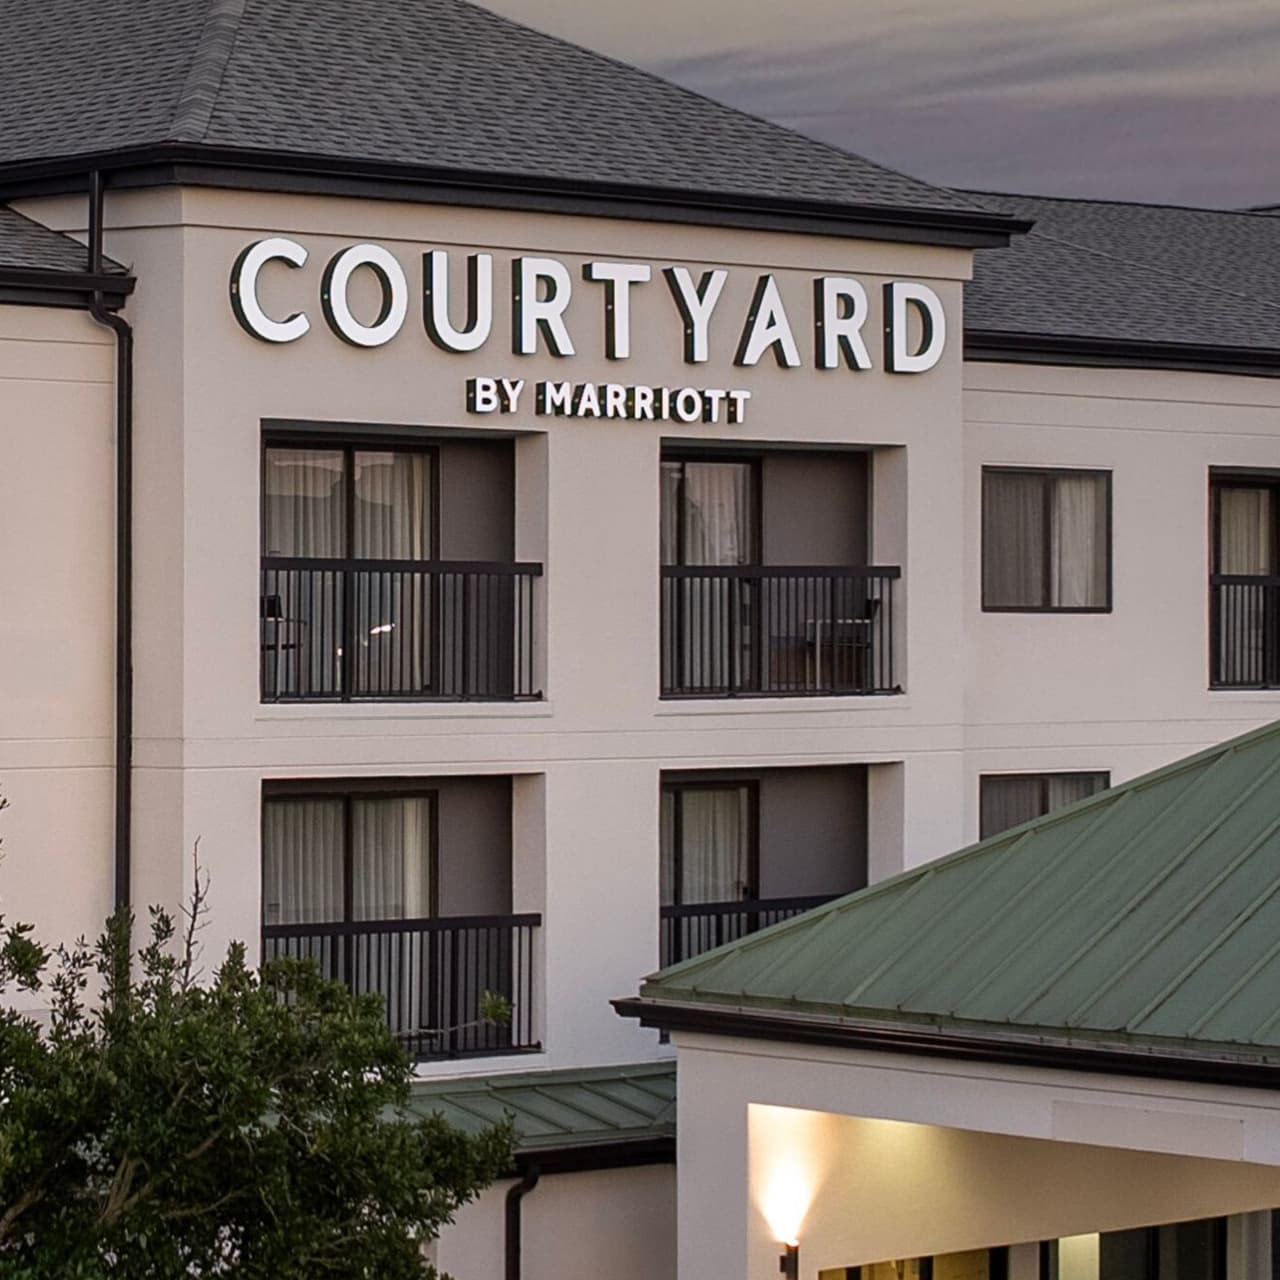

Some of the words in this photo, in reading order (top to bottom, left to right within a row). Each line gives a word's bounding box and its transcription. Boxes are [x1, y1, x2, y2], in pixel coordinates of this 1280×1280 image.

[230, 237, 947, 375] COURTYARD
[467, 376, 524, 414] BY
[536, 379, 751, 424] MARRIOTT
